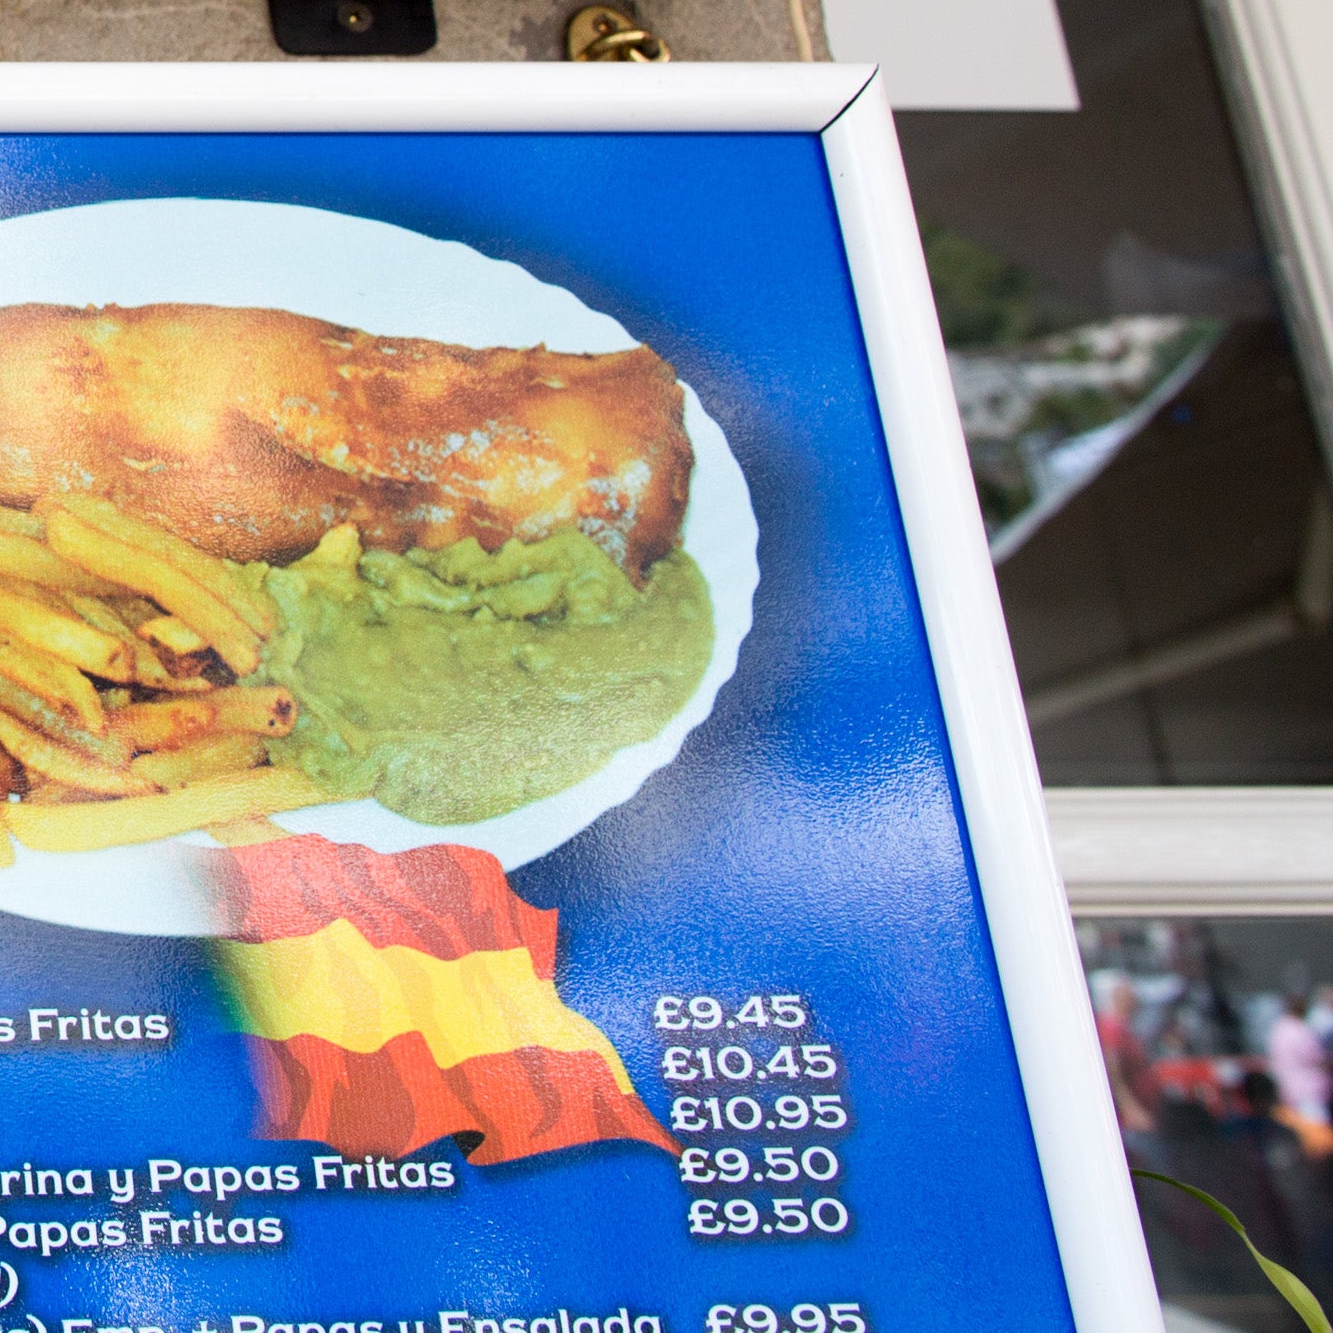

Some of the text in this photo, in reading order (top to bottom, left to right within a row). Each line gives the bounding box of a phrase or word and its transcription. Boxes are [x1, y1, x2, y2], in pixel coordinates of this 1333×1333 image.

[28, 1008, 170, 1041] Fritas
[653, 994, 807, 1031] £9.45
[661, 1044, 837, 1082] £10.45
[670, 1095, 847, 1132] £10.95
[108, 1169, 135, 1204] y
[149, 1159, 300, 1201] Papas
[313, 1155, 455, 1189] Fritas
[679, 1146, 839, 1183] £9.50
[139, 1210, 283, 1245] Fritas
[688, 1198, 849, 1235] £9.50
